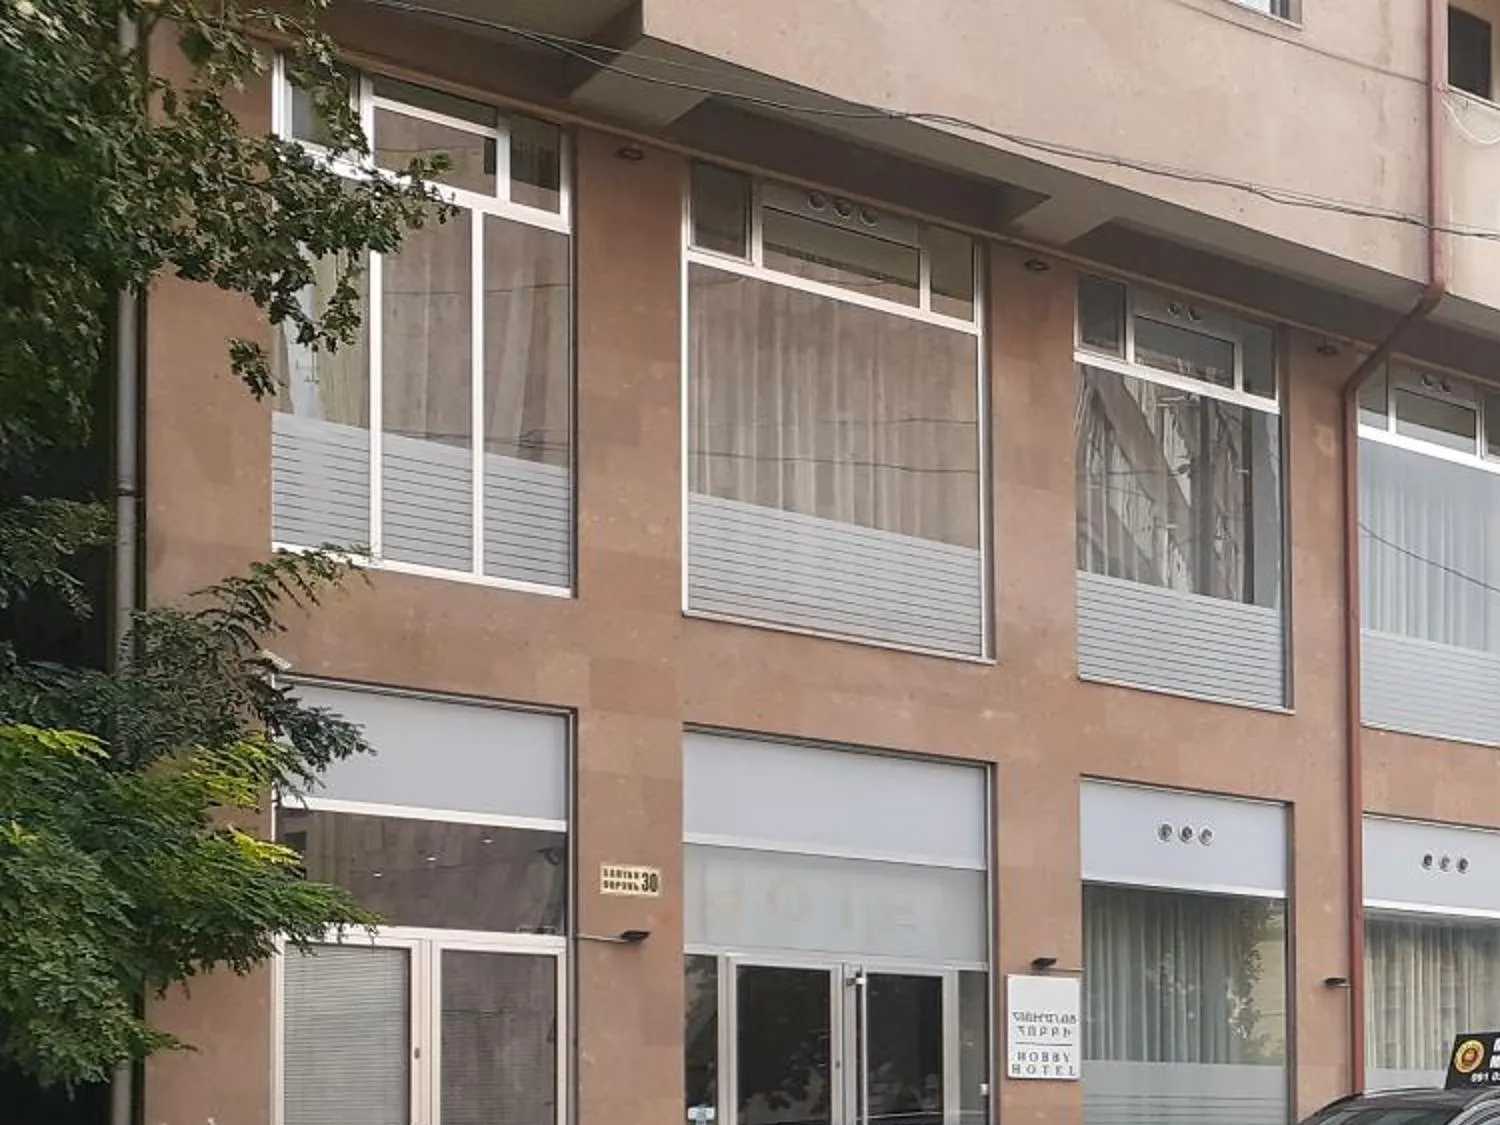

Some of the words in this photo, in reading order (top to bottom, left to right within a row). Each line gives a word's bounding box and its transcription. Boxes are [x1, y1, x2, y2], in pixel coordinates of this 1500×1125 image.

[641, 871, 658, 893] 30
[1018, 1051, 1070, 1063] HOBBY
[1012, 1063, 1077, 1076] HOTEL
